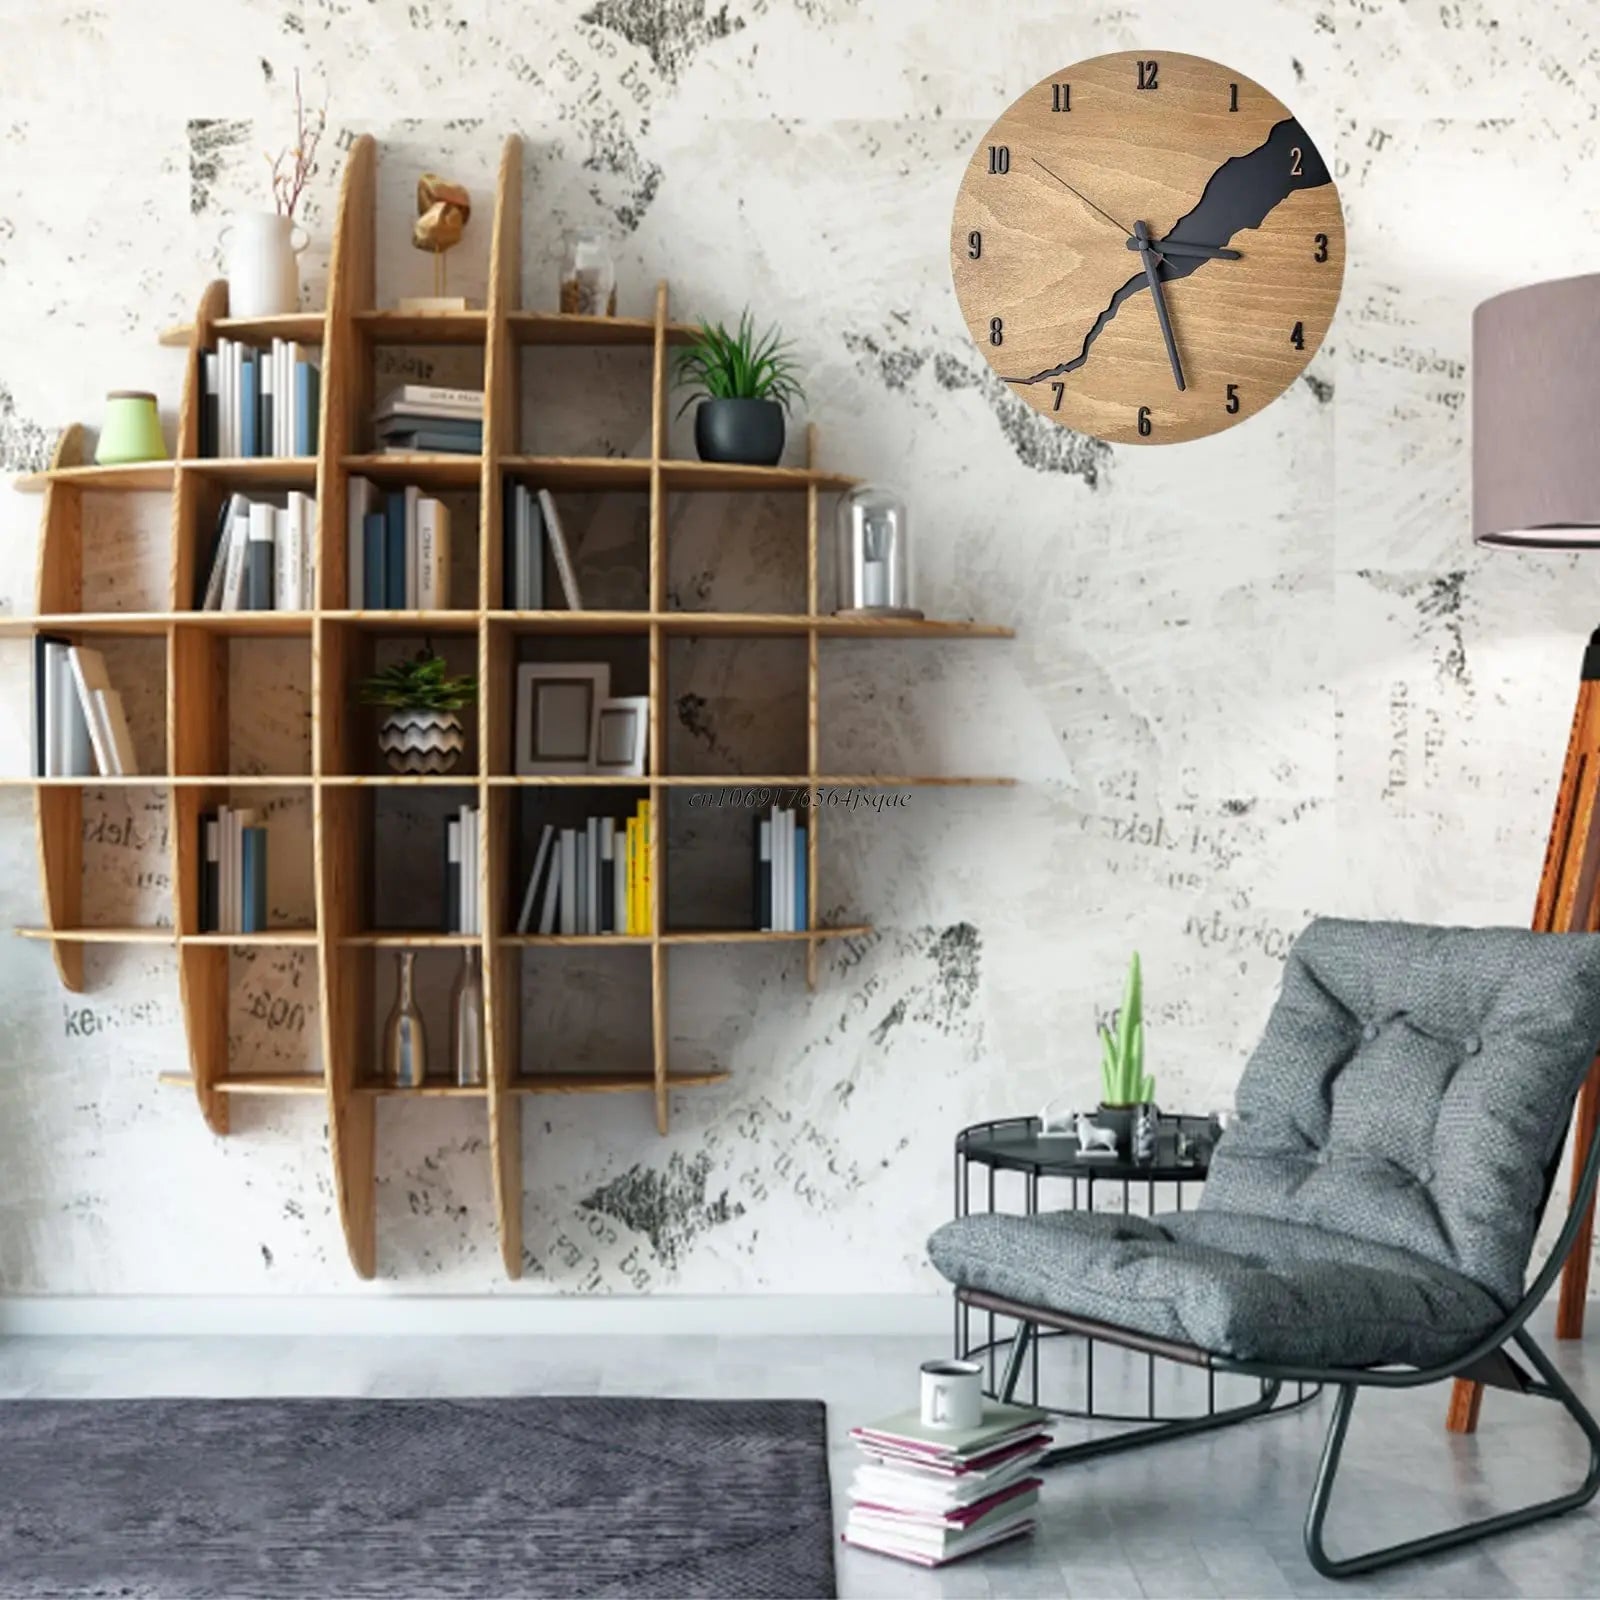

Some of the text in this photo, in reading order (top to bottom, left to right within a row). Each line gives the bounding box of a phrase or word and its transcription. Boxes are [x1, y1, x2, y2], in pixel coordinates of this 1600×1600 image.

[1136, 60, 1158, 90] 12
[1051, 84, 1072, 112] 11
[1228, 84, 1239, 112] 1
[987, 146, 1010, 175] 10
[1289, 146, 1303, 176] 2
[967, 231, 982, 260] 9
[1313, 233, 1329, 263] 3
[989, 317, 1003, 347] 8
[1290, 321, 1305, 351] 4
[1051, 382, 1065, 411] 7
[1225, 384, 1240, 415] 5
[1137, 406, 1152, 437] 6
